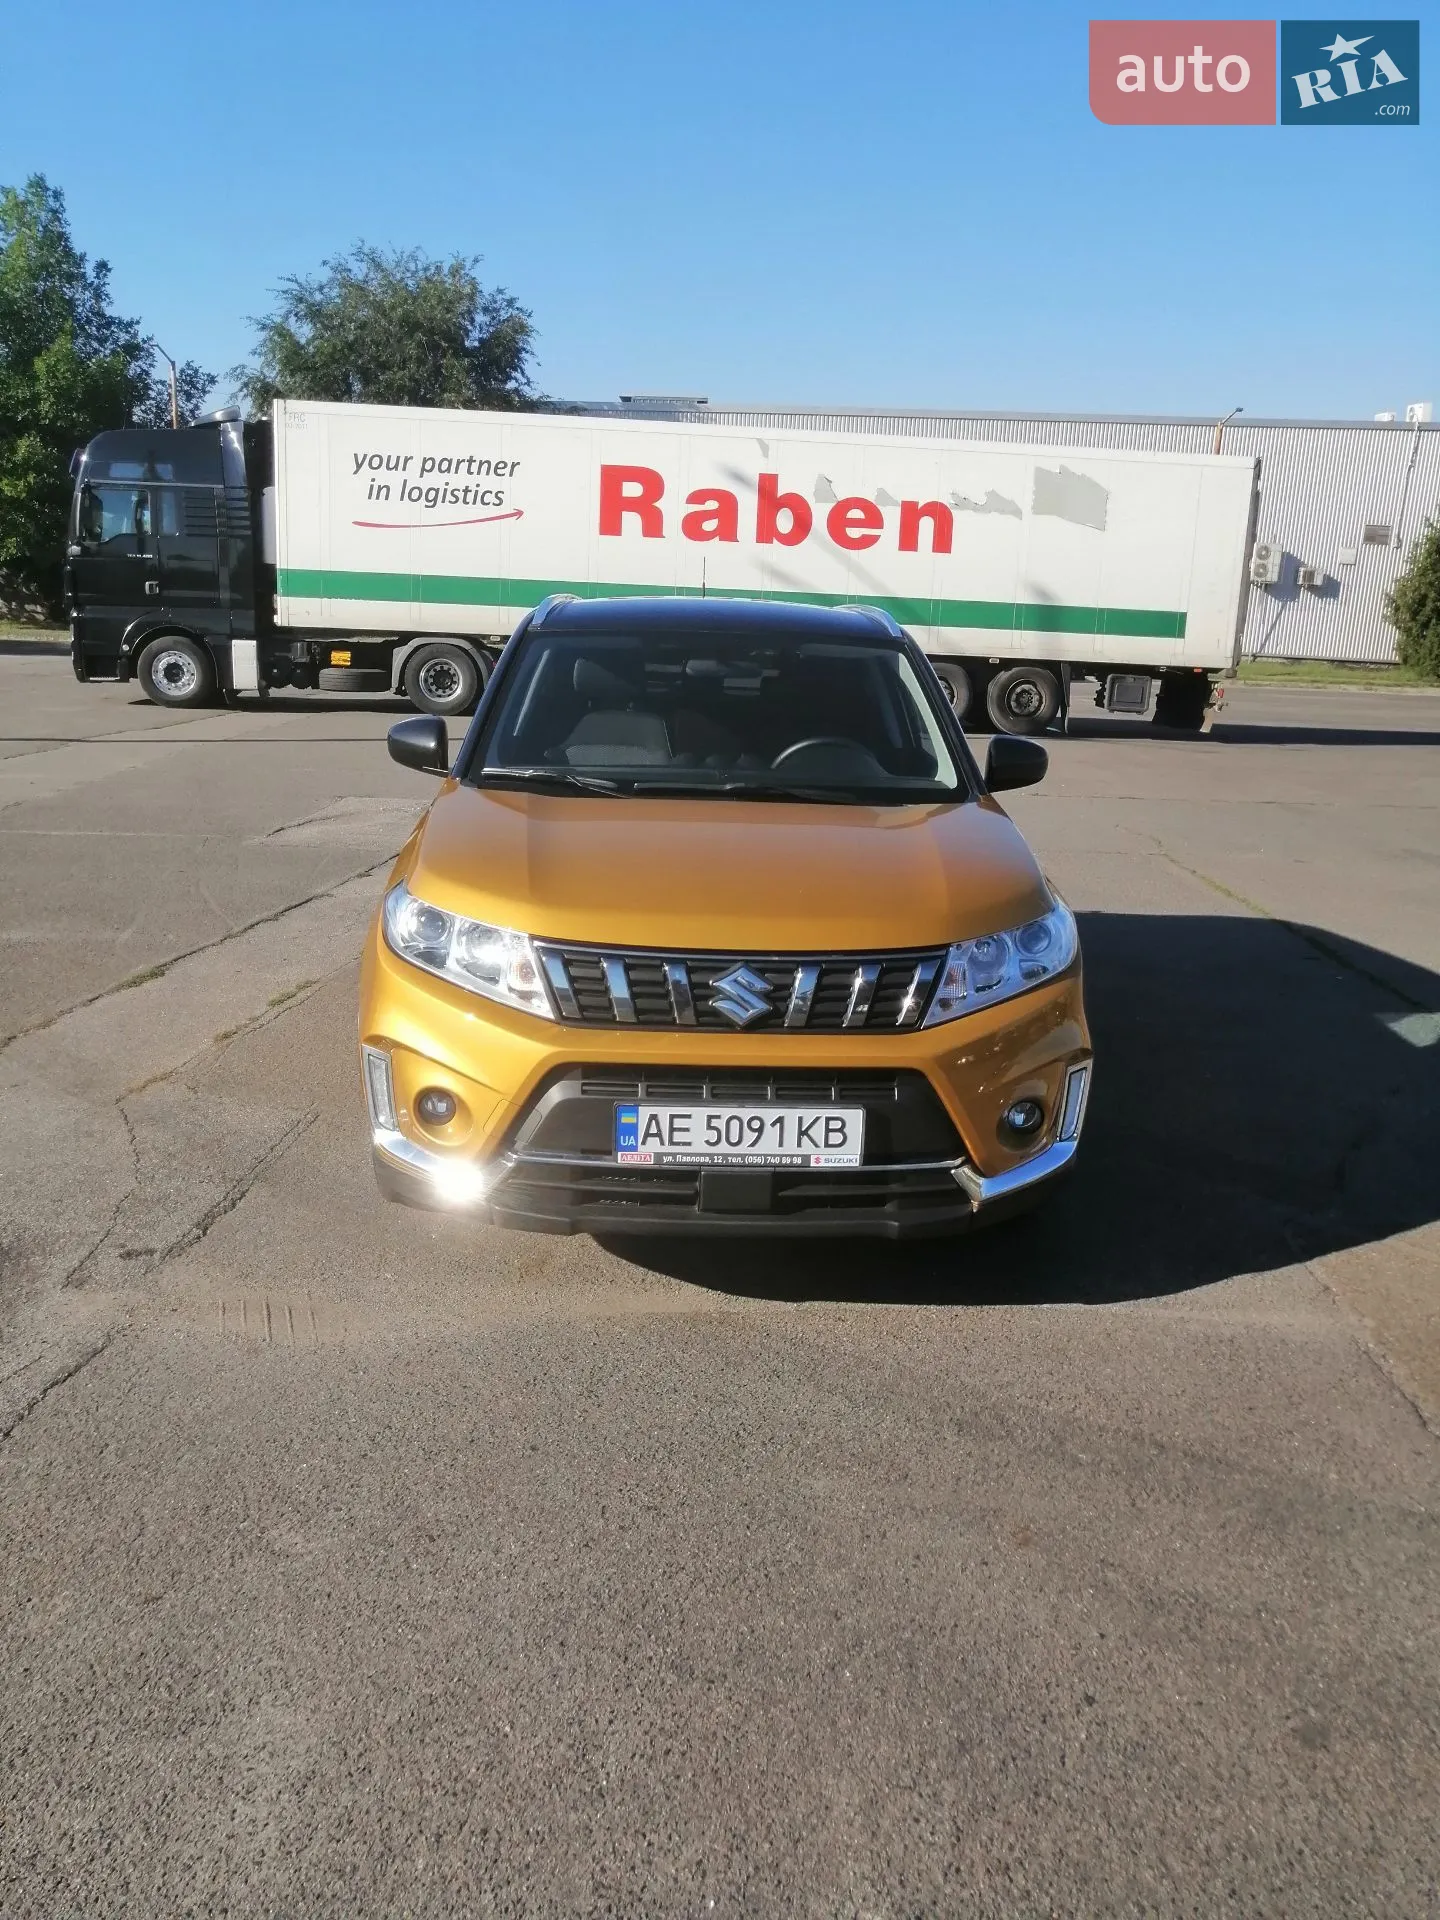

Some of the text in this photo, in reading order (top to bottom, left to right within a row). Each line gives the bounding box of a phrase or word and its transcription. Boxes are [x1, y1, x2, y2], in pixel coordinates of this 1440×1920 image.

[352, 452, 521, 478] your partner
[367, 477, 505, 509] in logistics
[598, 464, 954, 554] Raben
[620, 1135, 636, 1146] UA
[640, 1112, 848, 1149] AE 5091 KB
[662, 1155, 675, 1163] ул.
[676, 1155, 712, 1164] Павлова,
[727, 1156, 744, 1164] тел.
[745, 1156, 765, 1164] (056)
